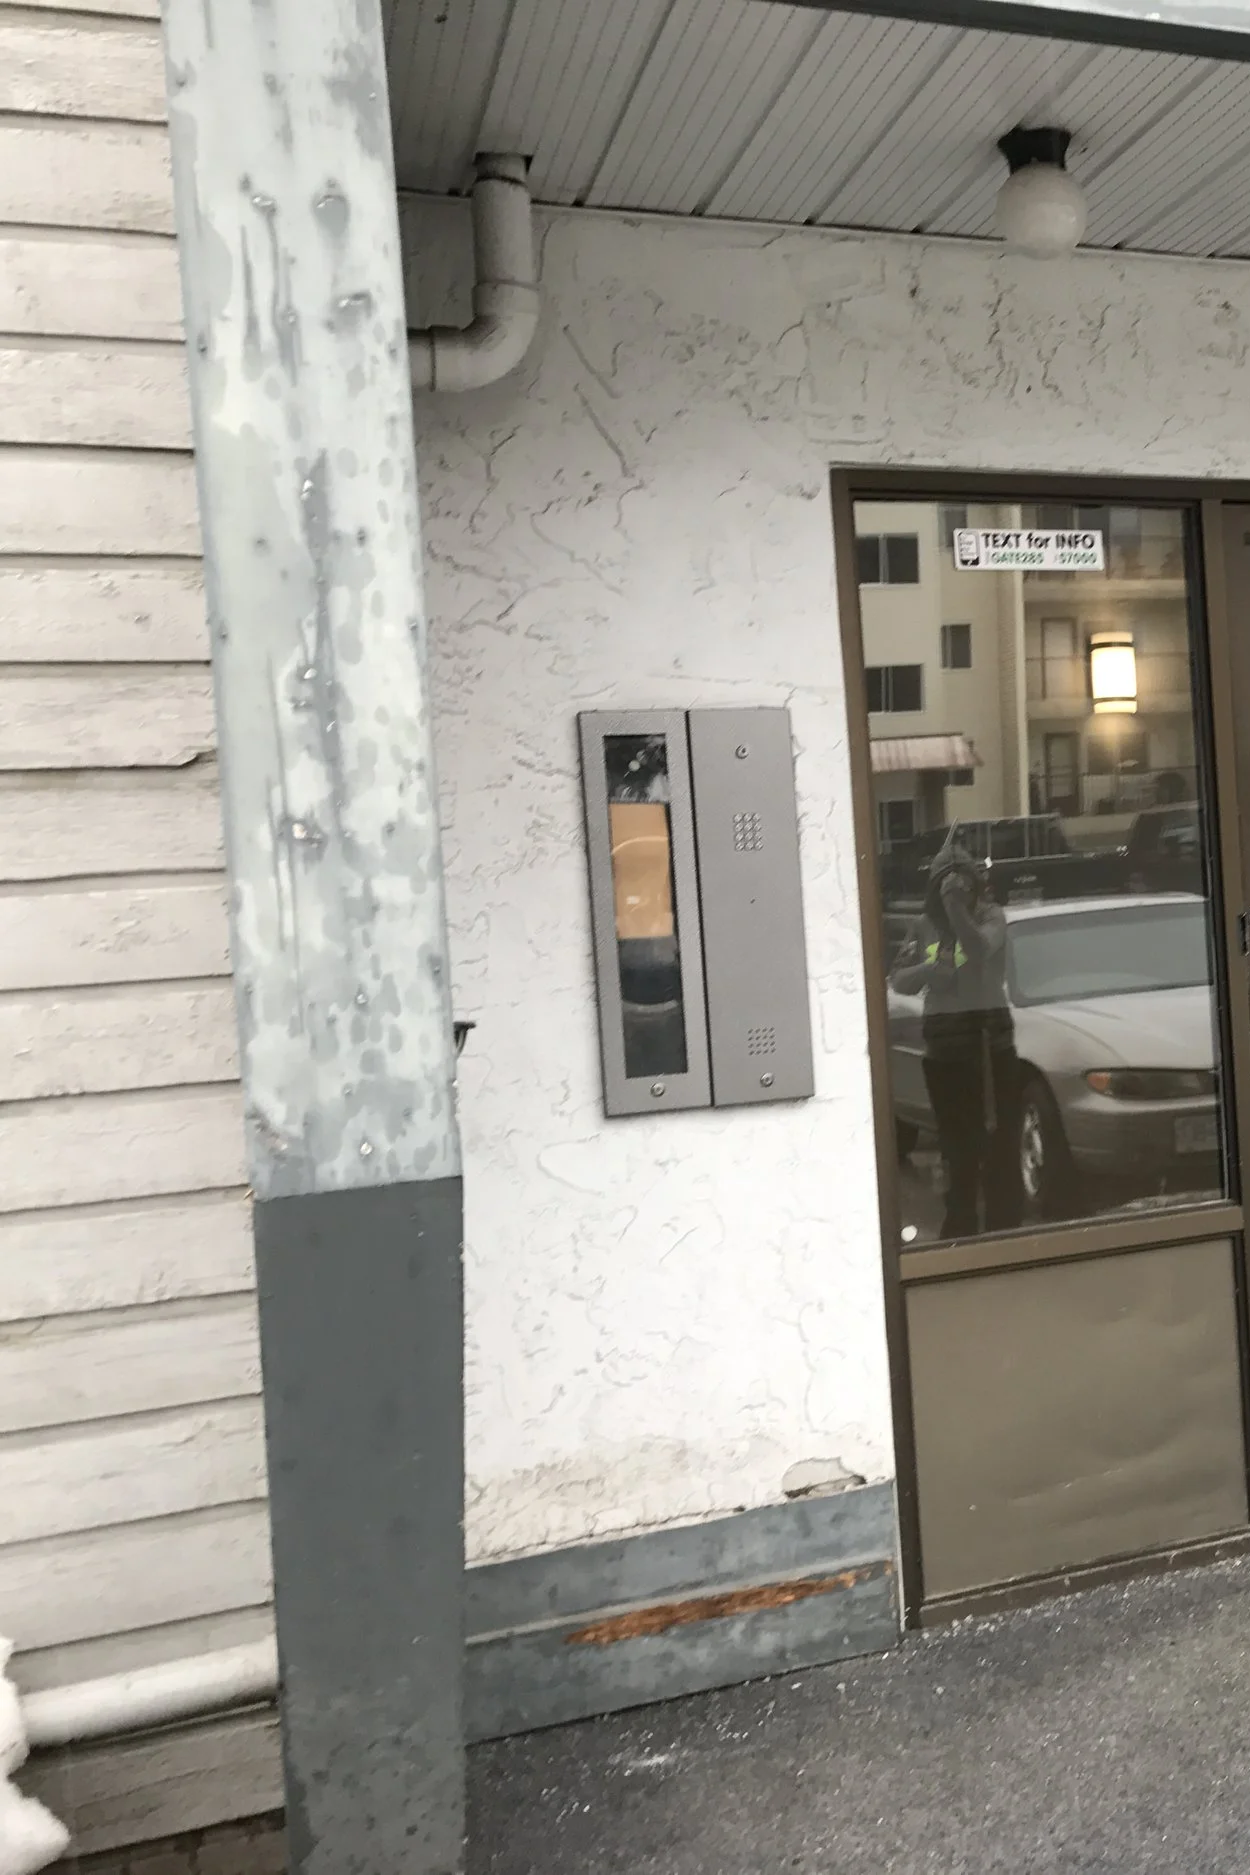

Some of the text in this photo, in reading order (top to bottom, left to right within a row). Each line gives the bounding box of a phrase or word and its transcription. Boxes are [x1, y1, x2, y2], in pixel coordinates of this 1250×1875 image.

[982, 532, 1095, 550] TEXT for INFO
